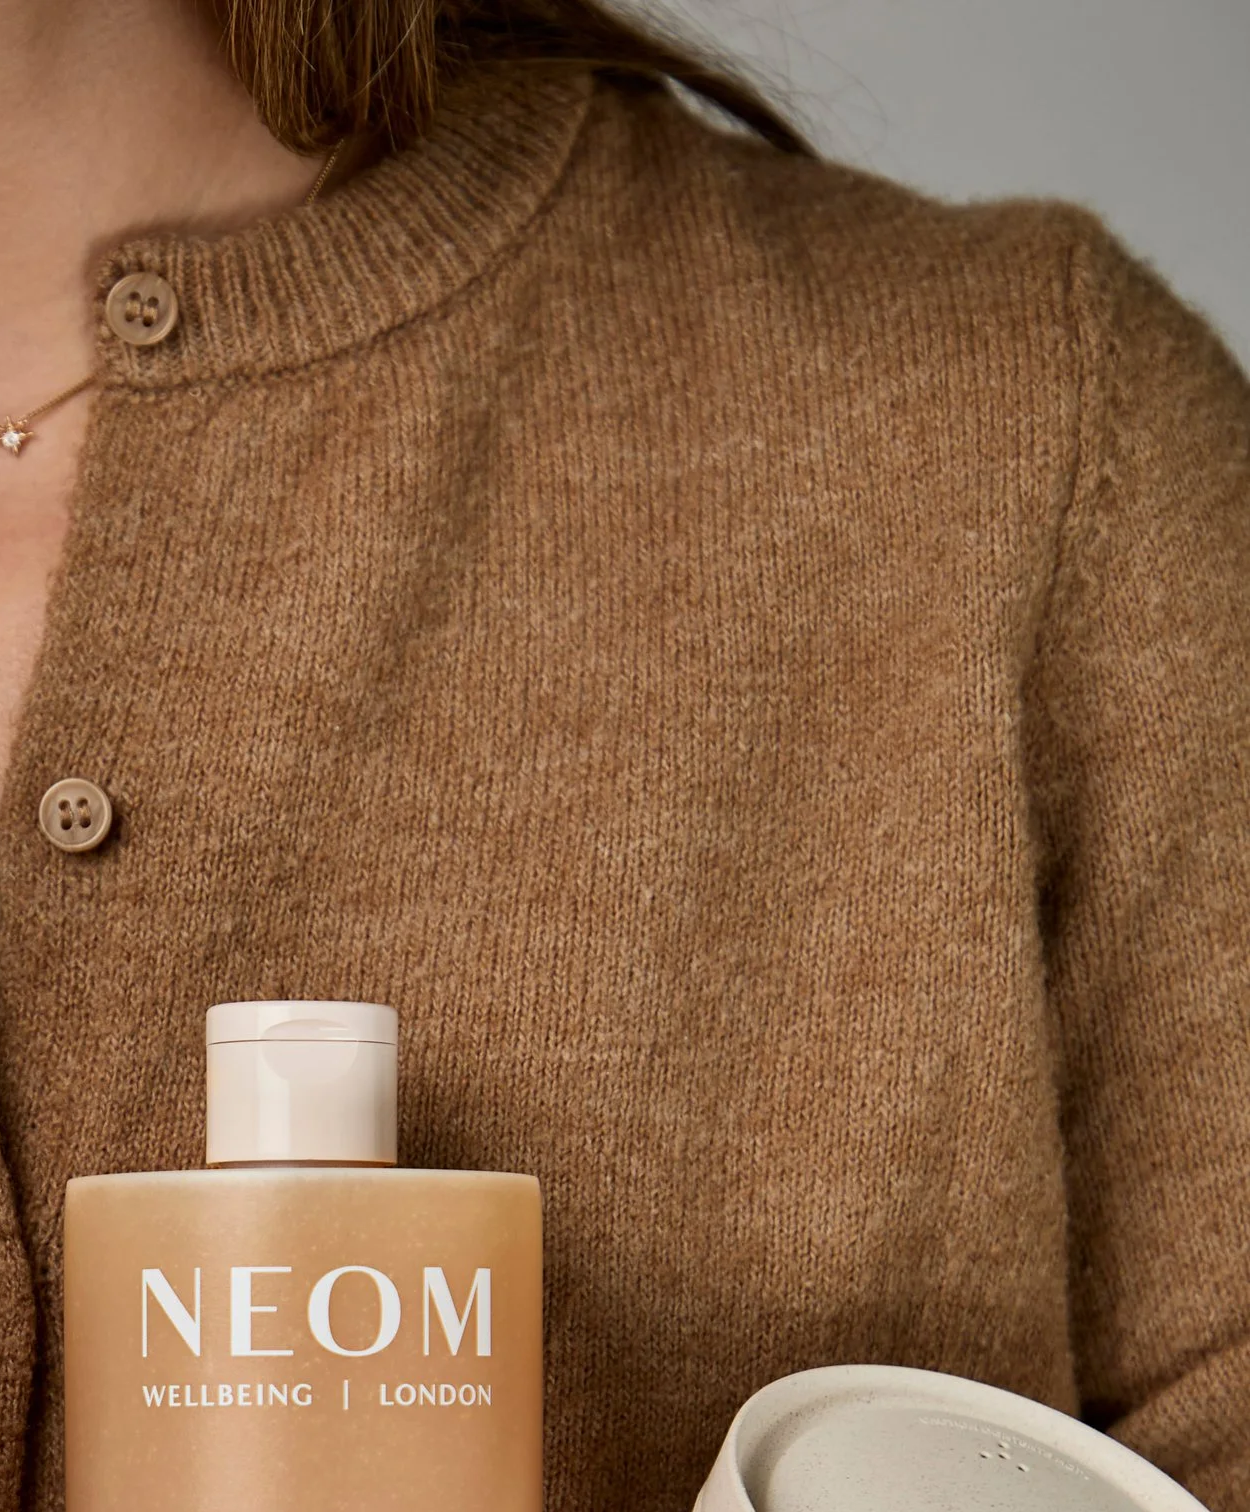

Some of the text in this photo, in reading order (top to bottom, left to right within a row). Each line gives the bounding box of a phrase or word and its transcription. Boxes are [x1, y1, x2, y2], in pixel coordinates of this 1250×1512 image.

[141, 1265, 492, 1359] NEOM
[142, 1383, 313, 1408] WELLBEING
[379, 1382, 492, 1407] LONDON
